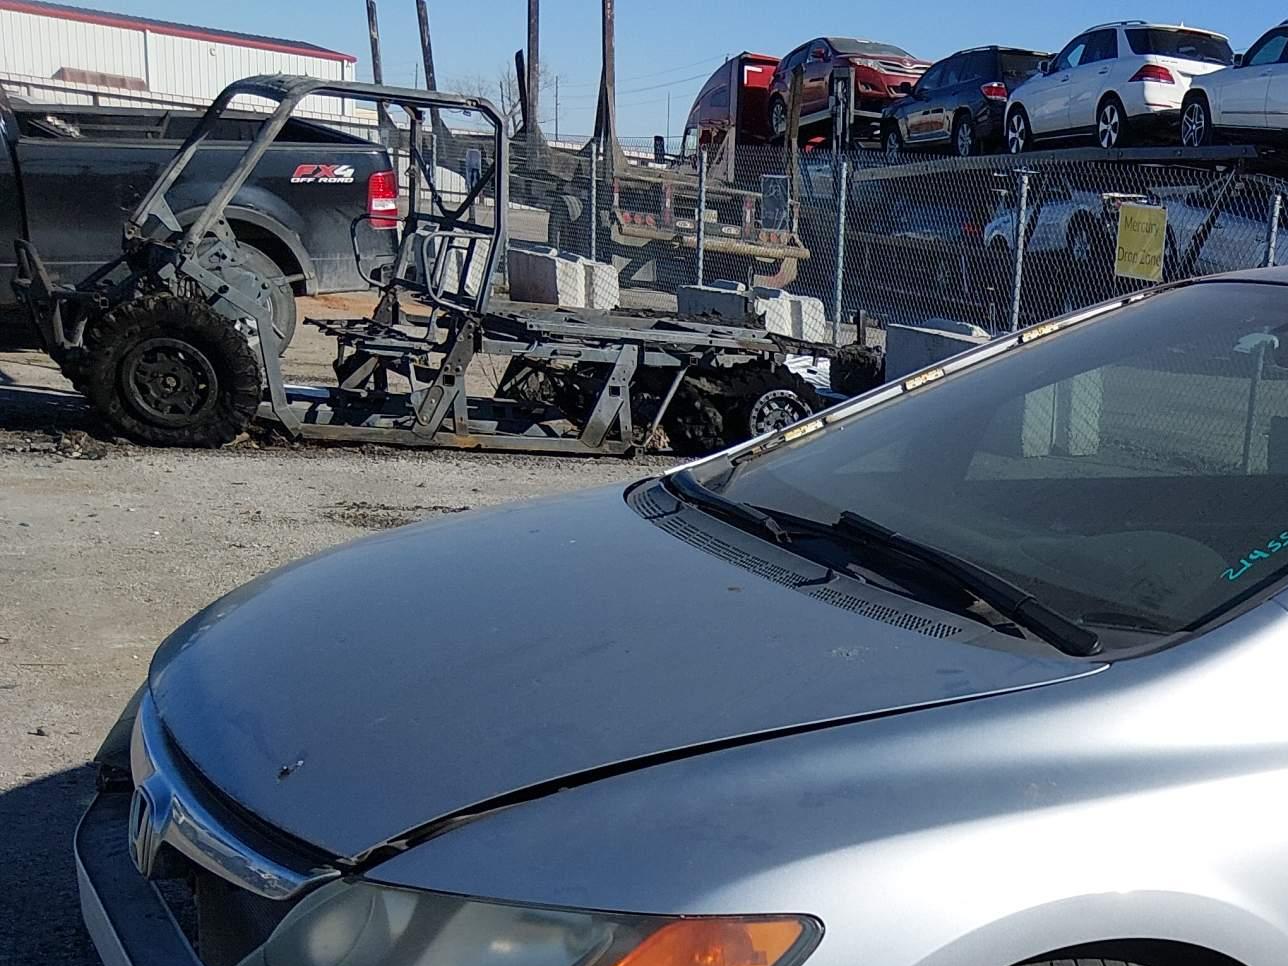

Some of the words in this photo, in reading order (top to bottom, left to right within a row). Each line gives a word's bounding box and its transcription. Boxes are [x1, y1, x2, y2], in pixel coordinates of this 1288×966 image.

[292, 164, 355, 178] FX4
[1124, 215, 1159, 236] Mercury
[1117, 246, 1138, 264] Drop
[1139, 250, 1161, 267] Zone
